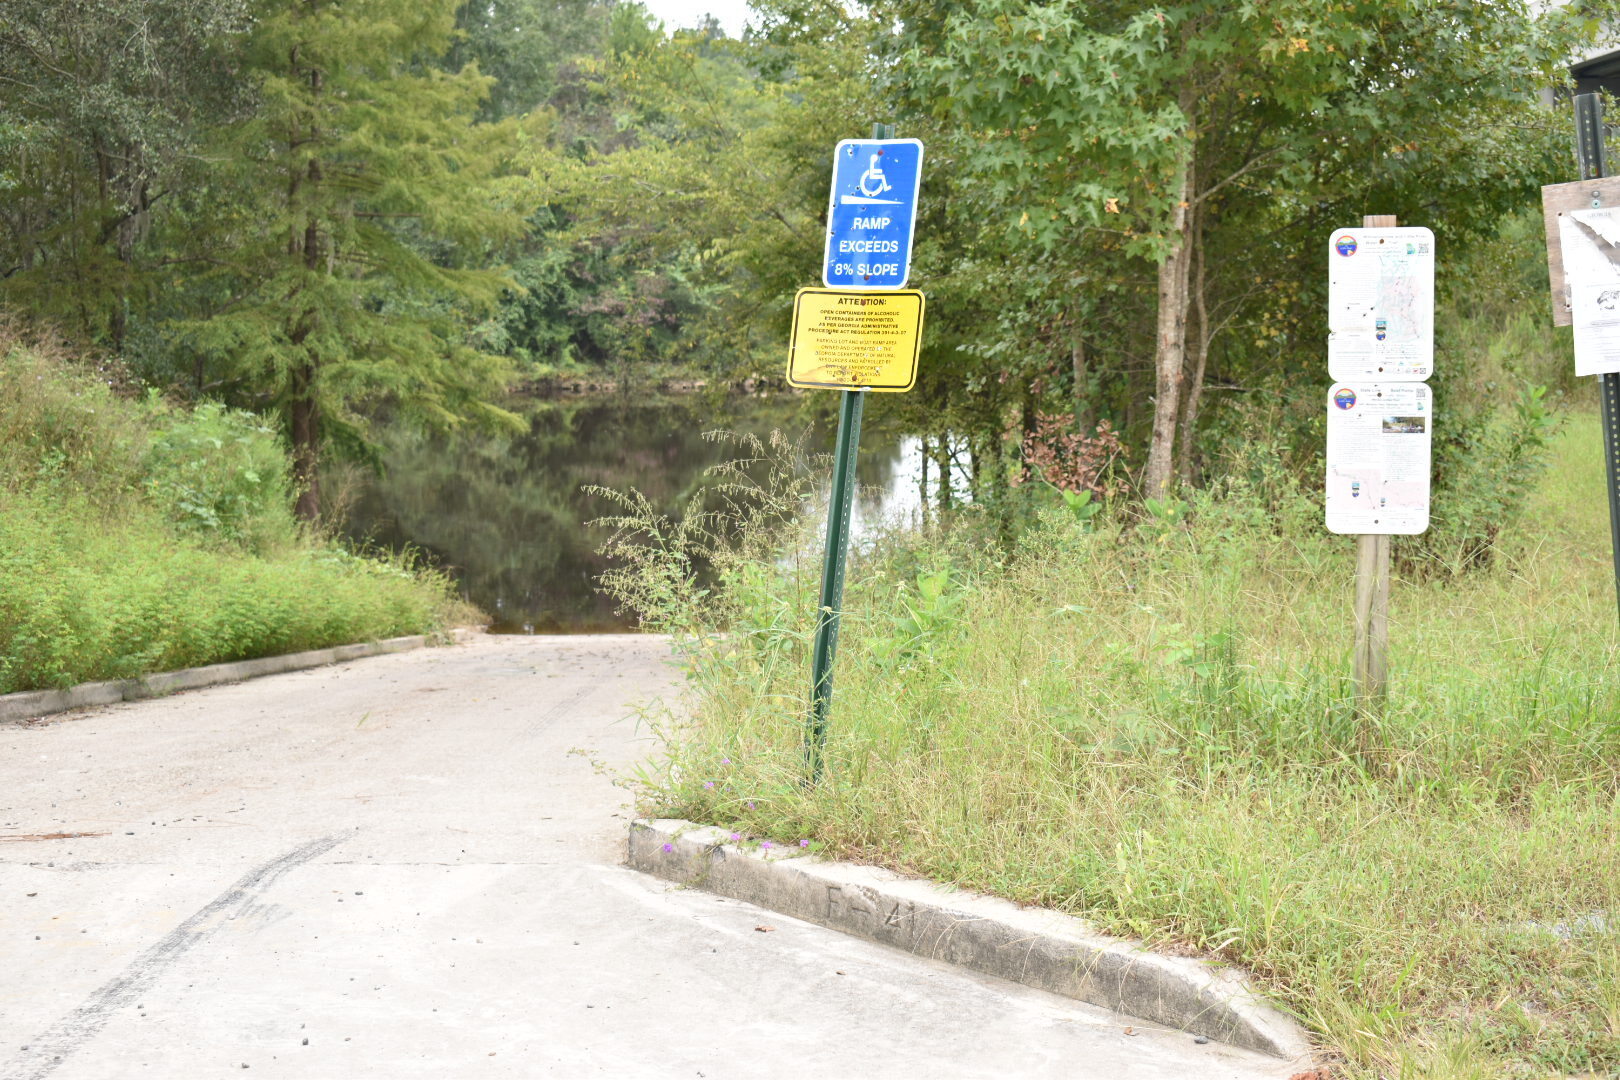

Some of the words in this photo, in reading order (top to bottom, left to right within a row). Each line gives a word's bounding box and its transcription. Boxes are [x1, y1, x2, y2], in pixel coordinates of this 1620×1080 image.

[853, 218, 890, 230] RAMP
[840, 240, 898, 253] EXCEEDS
[835, 263, 853, 275] 8%
[857, 263, 898, 275] SLOPE
